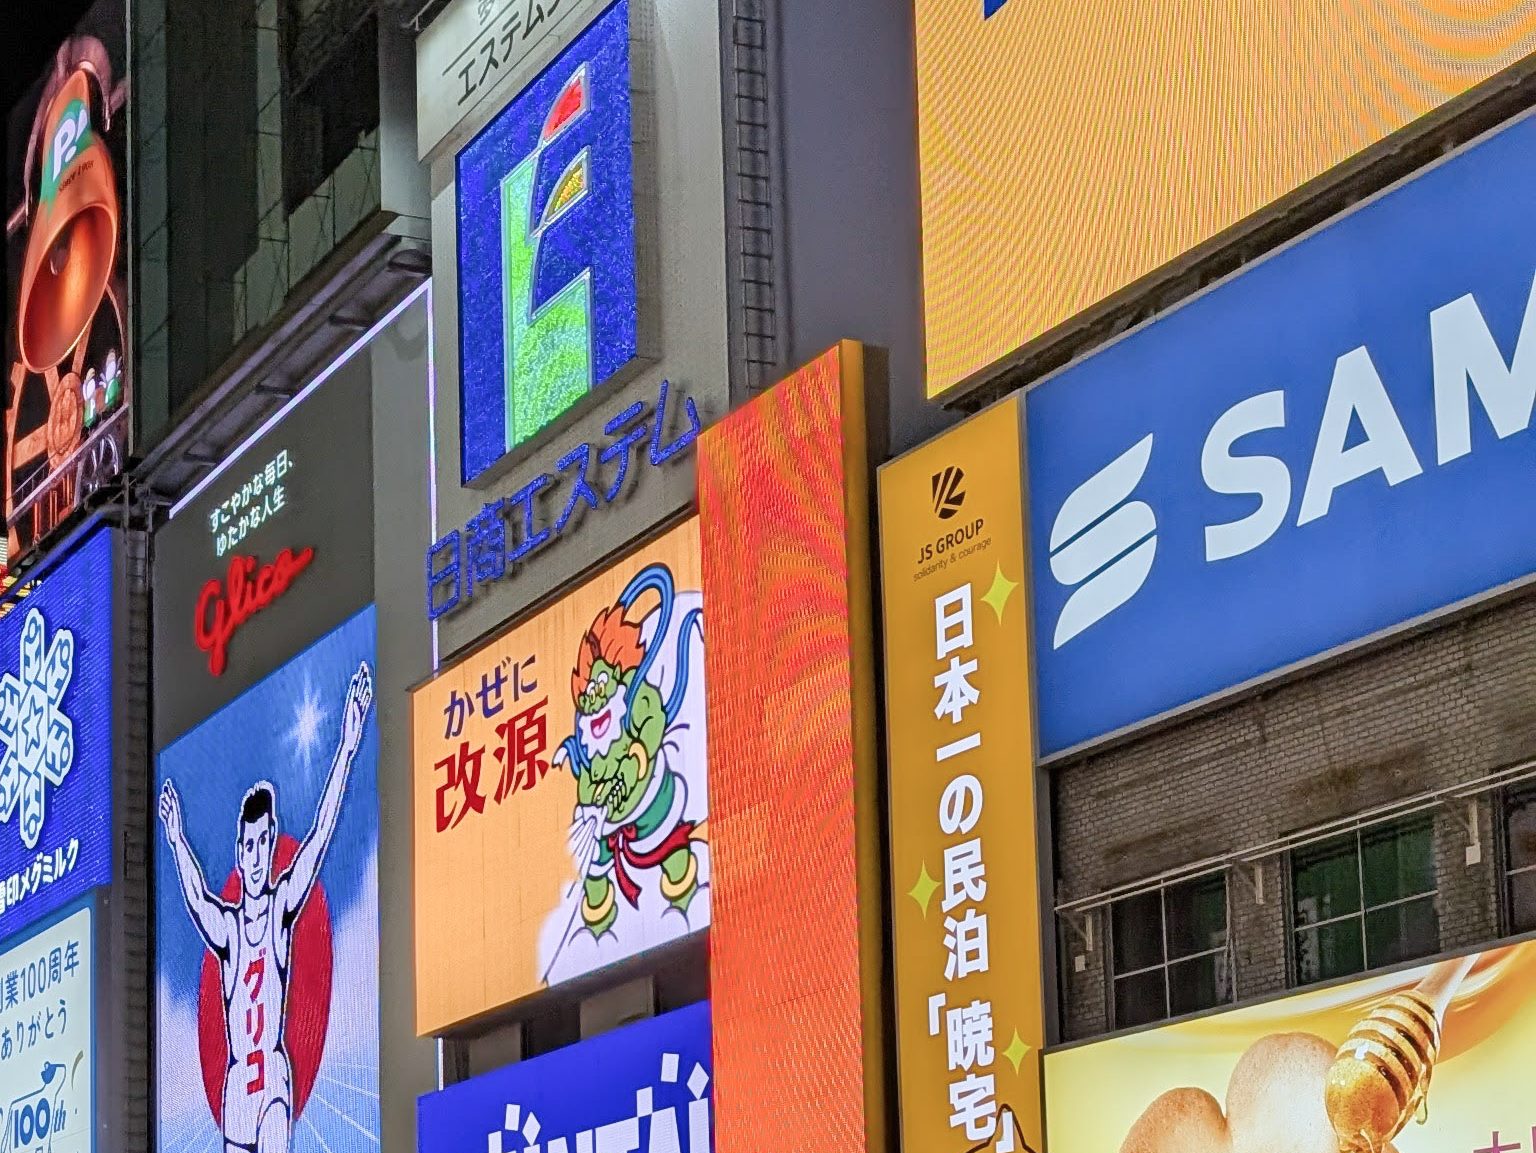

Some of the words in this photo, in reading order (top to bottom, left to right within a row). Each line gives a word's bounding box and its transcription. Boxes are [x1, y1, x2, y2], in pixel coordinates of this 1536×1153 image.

[210, 449, 293, 533] すこやかな毎日、
[216, 485, 285, 556] ゆたかな人生
[427, 379, 701, 621] 日商エステム
[918, 543, 933, 564] JS
[936, 518, 984, 555] GROUP
[194, 547, 314, 677] Glico
[443, 654, 538, 740] かぜに
[433, 696, 549, 834] 改源
[1, 998, 67, 1062] ありがとう
[243, 947, 266, 1096] グリコ
